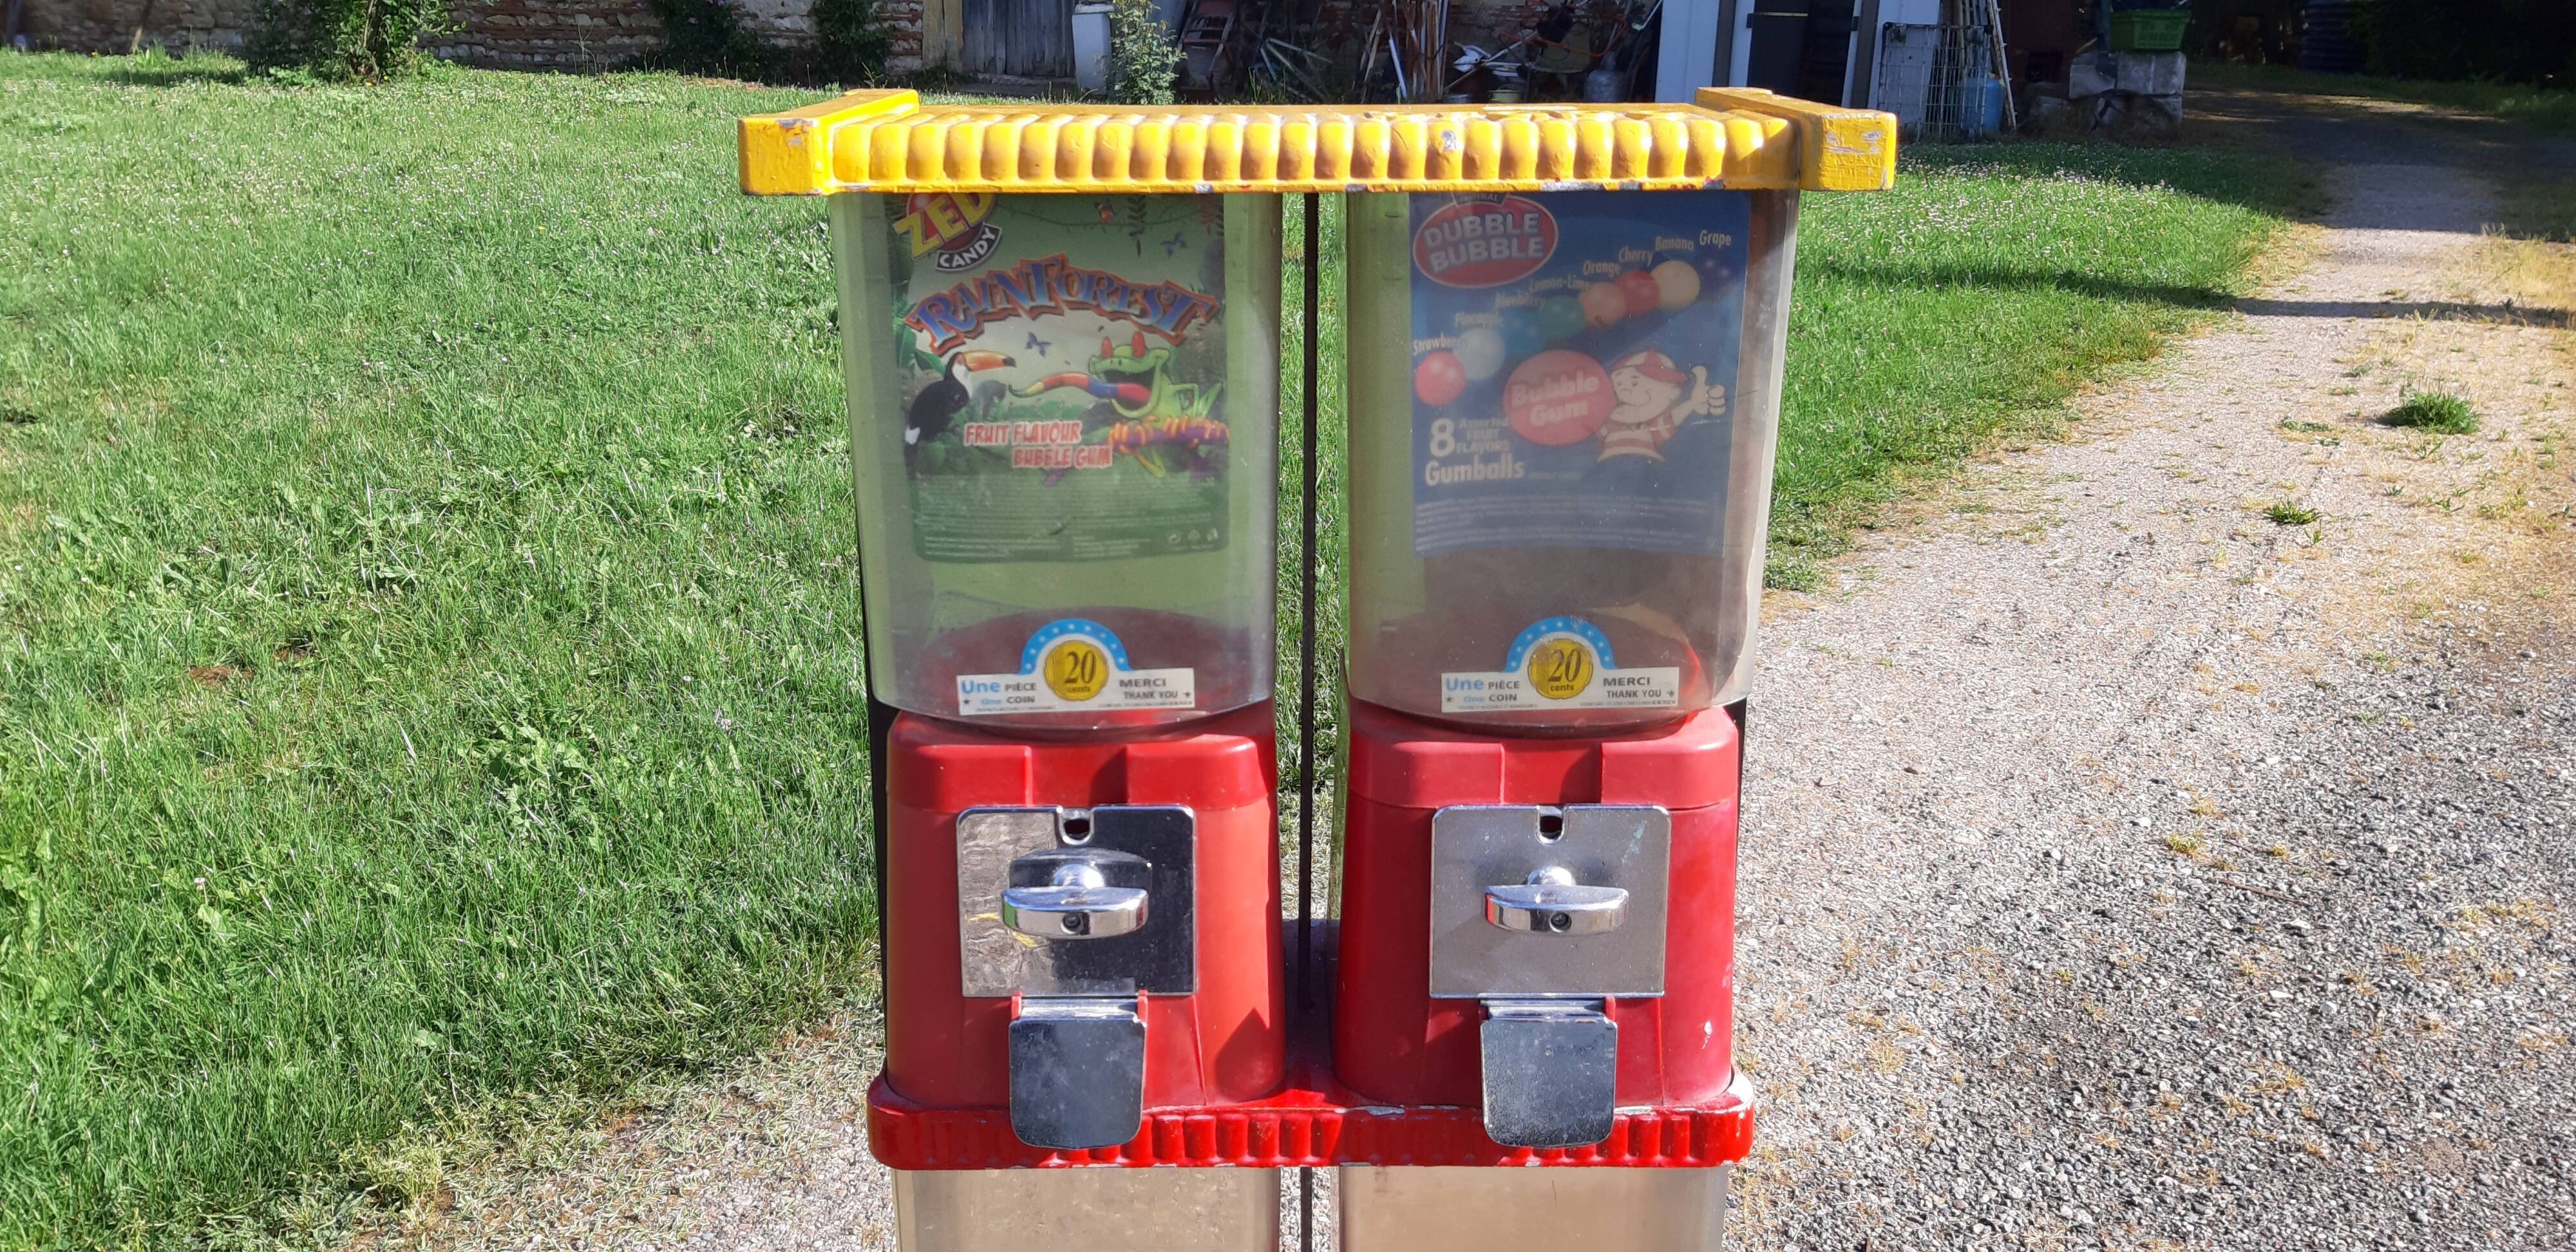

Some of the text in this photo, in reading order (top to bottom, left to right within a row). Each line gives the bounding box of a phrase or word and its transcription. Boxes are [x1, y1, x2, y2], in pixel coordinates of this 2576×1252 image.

[893, 192, 993, 259] ZED
[1425, 212, 1540, 249] DUBBLE
[940, 228, 995, 267] CANDY
[1654, 236, 1694, 252] Banana
[1699, 229, 1731, 247] Grape
[1430, 236, 1544, 273] BUBBLE
[1618, 246, 1653, 266] Cherry
[1583, 260, 1620, 277] Orange
[1511, 370, 1599, 407] Bubble
[1530, 400, 1589, 426] Gum
[966, 421, 1081, 444] FRUIT FLAVOUR
[1430, 419, 1455, 457] 8
[1013, 445, 1112, 468] BUBBLE GUM
[1425, 452, 1525, 487] Gumballs
[1064, 650, 1096, 685] 20
[1548, 649, 1582, 683] 20
[961, 680, 1000, 694] Une
[1119, 678, 1167, 688] MERCI
[1446, 678, 1520, 692] Une PIÈCE
[1550, 683, 1575, 692] cents
[1603, 677, 1651, 687] MERCI
[1007, 695, 1035, 704] COIN
[1124, 690, 1179, 700] THANK YOU
[1489, 693, 1517, 703] COIN
[1606, 689, 1662, 699] THANK YOU
